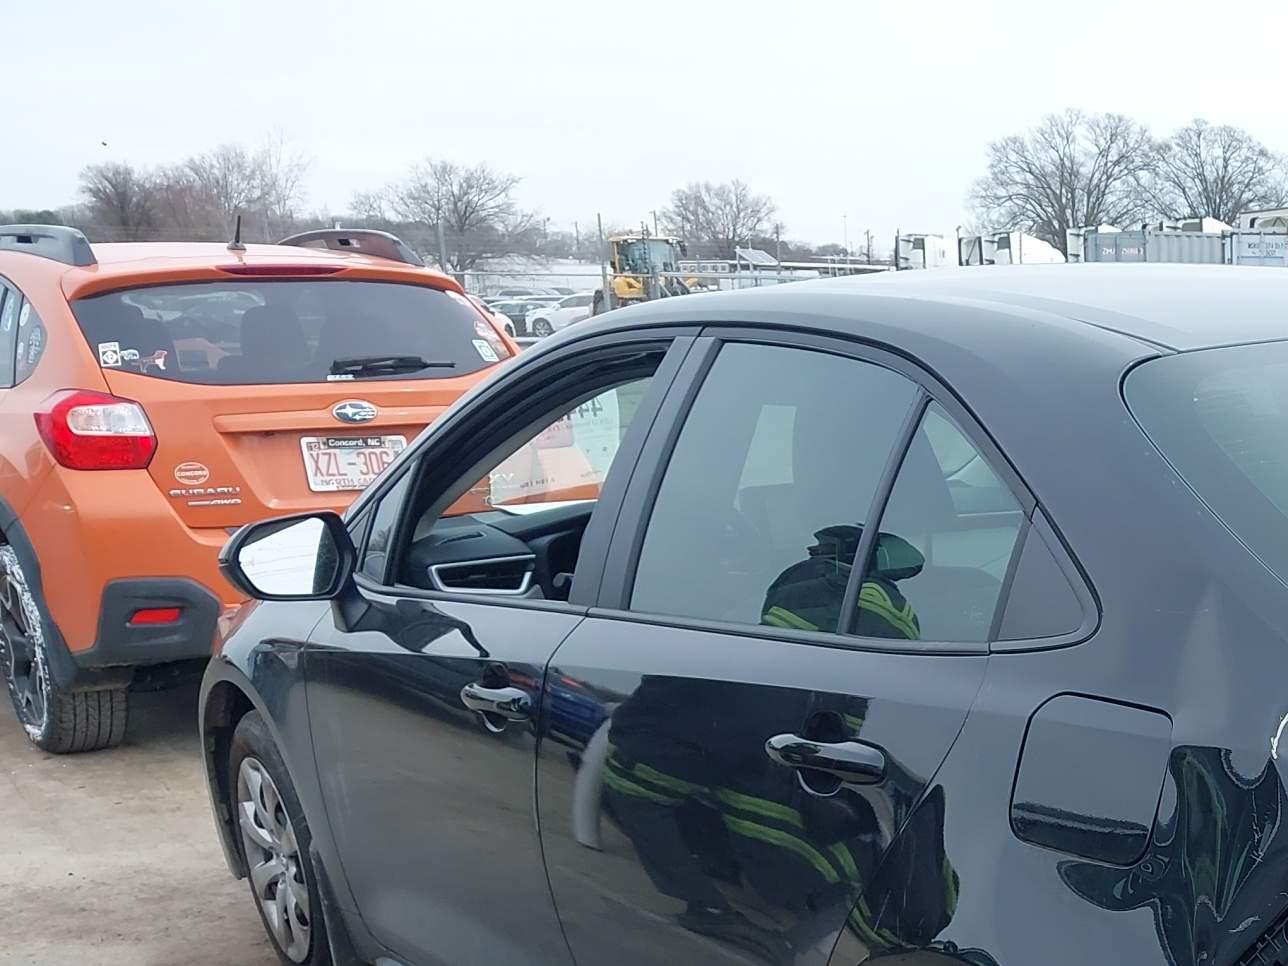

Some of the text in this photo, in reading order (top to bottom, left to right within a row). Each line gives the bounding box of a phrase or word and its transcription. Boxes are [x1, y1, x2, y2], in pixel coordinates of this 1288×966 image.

[328, 438, 366, 447] Concord,
[367, 438, 381, 446] NC
[169, 487, 241, 497] SUBARU
